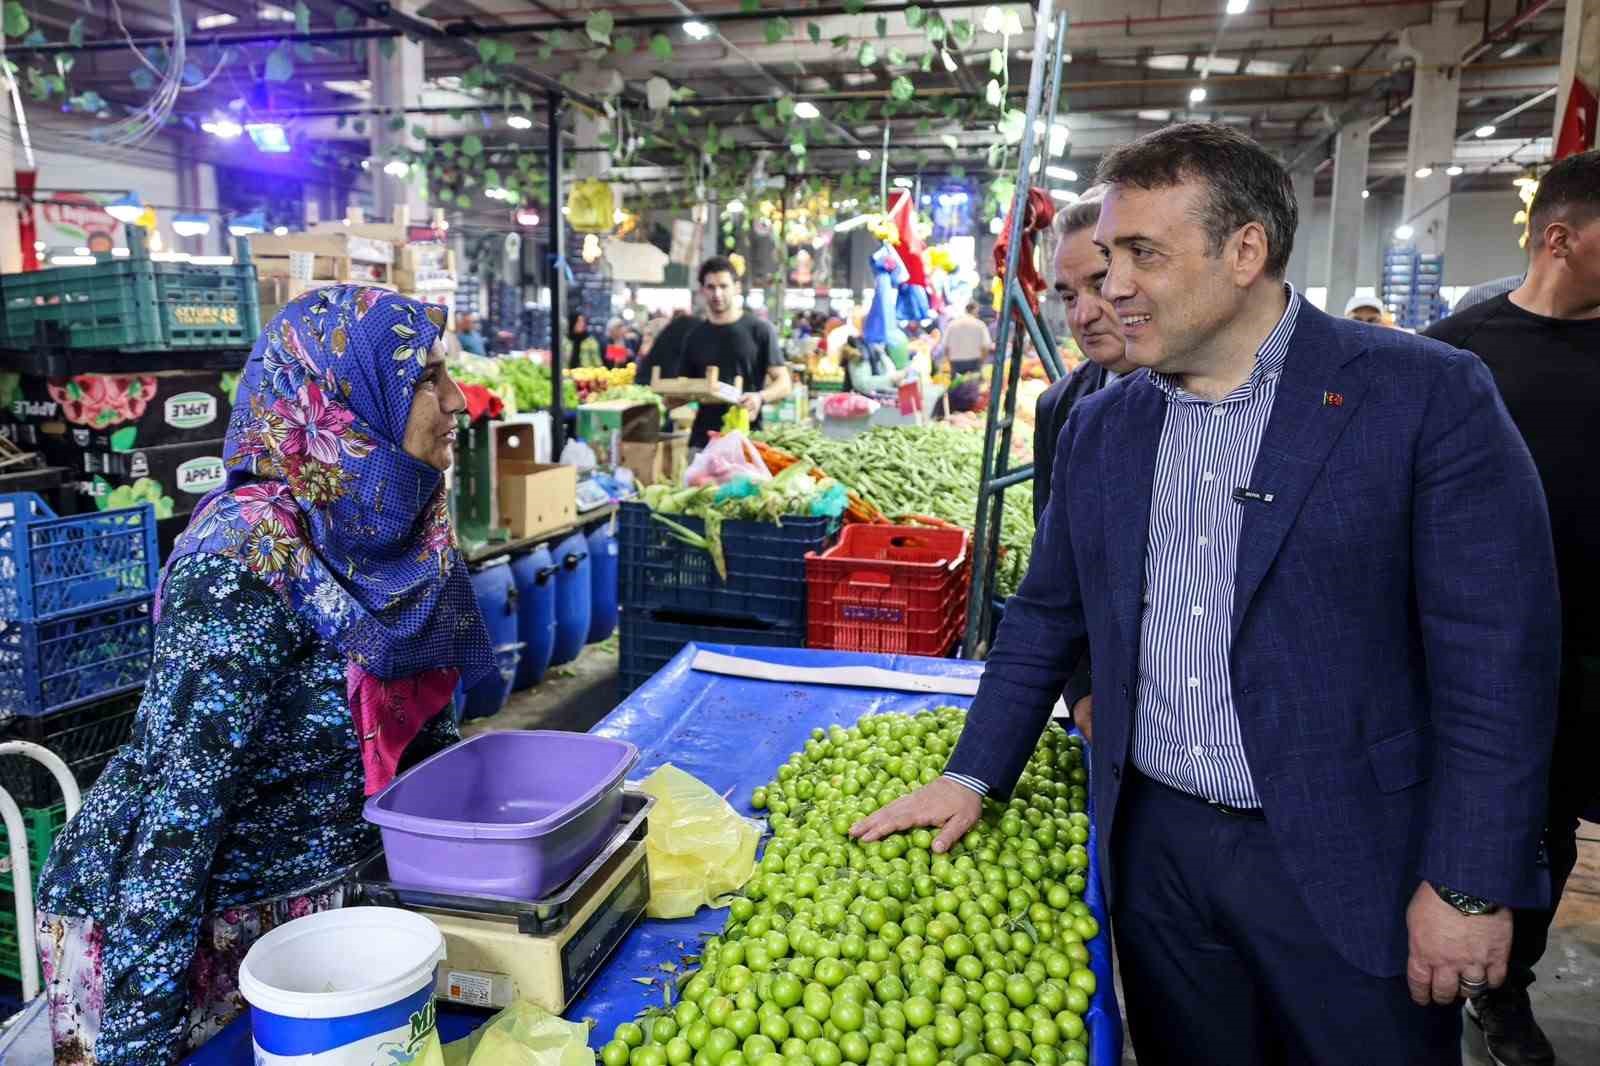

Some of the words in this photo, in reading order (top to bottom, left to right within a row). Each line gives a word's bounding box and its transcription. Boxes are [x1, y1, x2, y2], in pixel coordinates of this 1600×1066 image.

[13, 400, 57, 416] APPLE
[172, 403, 209, 417] APPLE
[184, 467, 221, 484] APPLE
